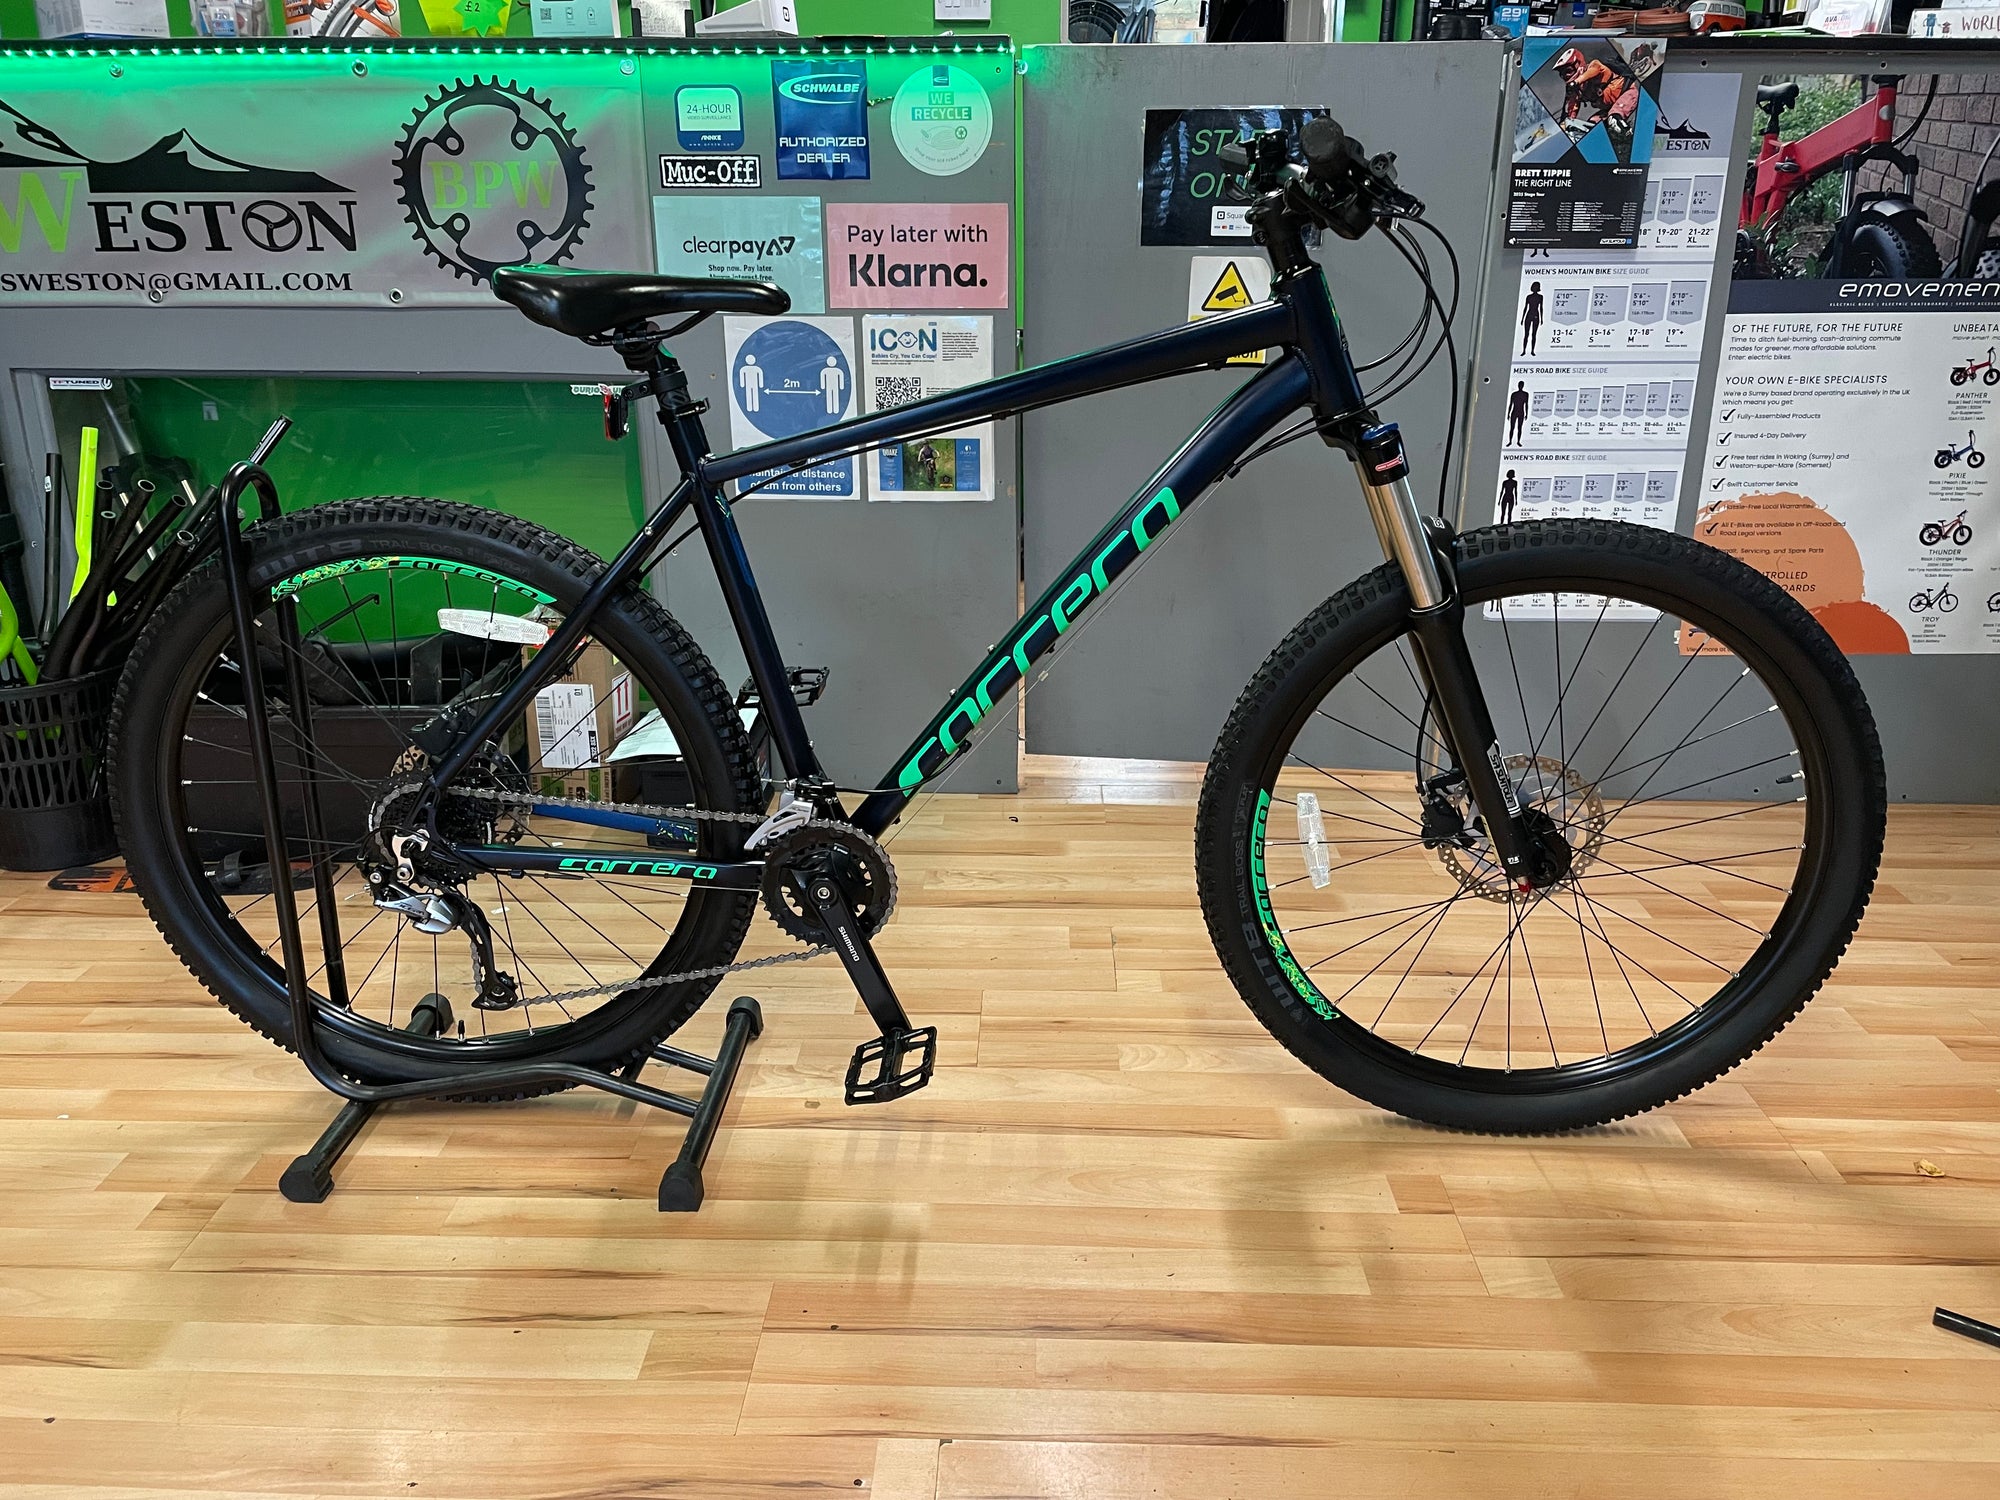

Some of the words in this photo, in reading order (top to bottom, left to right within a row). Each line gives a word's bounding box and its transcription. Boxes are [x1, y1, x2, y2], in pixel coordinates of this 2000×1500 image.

[793, 83, 860, 94] SCHWALBE
[930, 93, 953, 105] WE
[686, 103, 732, 115] 24-HOUR
[914, 108, 971, 121] RECYCLE
[779, 137, 867, 148] AUTHORIZED
[797, 153, 851, 164] DEALER
[666, 161, 755, 185] Muc-Off
[1515, 169, 1541, 177] BRETT
[1543, 169, 1571, 177] TIPPIE
[427, 161, 559, 209] BPW
[1514, 179, 1529, 188] THE
[1530, 179, 1554, 188] RIGHT
[1555, 179, 1572, 188] LINE
[1226, 213, 1244, 222] Squar
[847, 225, 884, 245] Pay
[891, 225, 938, 243] later
[945, 225, 988, 243] with
[683, 236, 766, 260] clearpay
[708, 265, 725, 274] Shop
[743, 265, 755, 274] Pay
[849, 254, 988, 288] Klarna.
[2, 272, 352, 292] SWESTON@GMAIL.COM
[1732, 324, 1747, 333] OF
[1751, 324, 1770, 333] THE
[1773, 324, 1813, 334] FUTURE,
[1816, 324, 1838, 332] FOR
[1841, 323, 1861, 332] THE
[1863, 323, 1903, 332] FUTURE
[1820, 335, 1867, 343] cash-draining
[784, 378, 801, 389] 2m
[1725, 376, 1754, 385] YOUR
[1757, 376, 1784, 385] OWN
[1787, 376, 1821, 384] E-BIKE
[1823, 375, 1888, 384] SPECIALISTS
[1814, 389, 1845, 397] operating
[1737, 413, 1791, 421] Fully-Assembled
[1759, 432, 1780, 440] 4-Day
[1780, 432, 1807, 440] Delivery
[1783, 453, 1808, 461] Woking
[1808, 452, 1835, 461] (Surrey)
[1729, 461, 1795, 470] Weston-super-Mare
[1795, 460, 1832, 469] (Somerset)
[802, 469, 846, 479] distance
[783, 481, 807, 491] from
[810, 482, 842, 492] others
[389, 559, 538, 598] carrera
[898, 486, 1182, 798] carrera
[558, 858, 718, 881] carrera
[1253, 803, 1277, 933] carrera
[837, 925, 860, 963] SHIMANO
